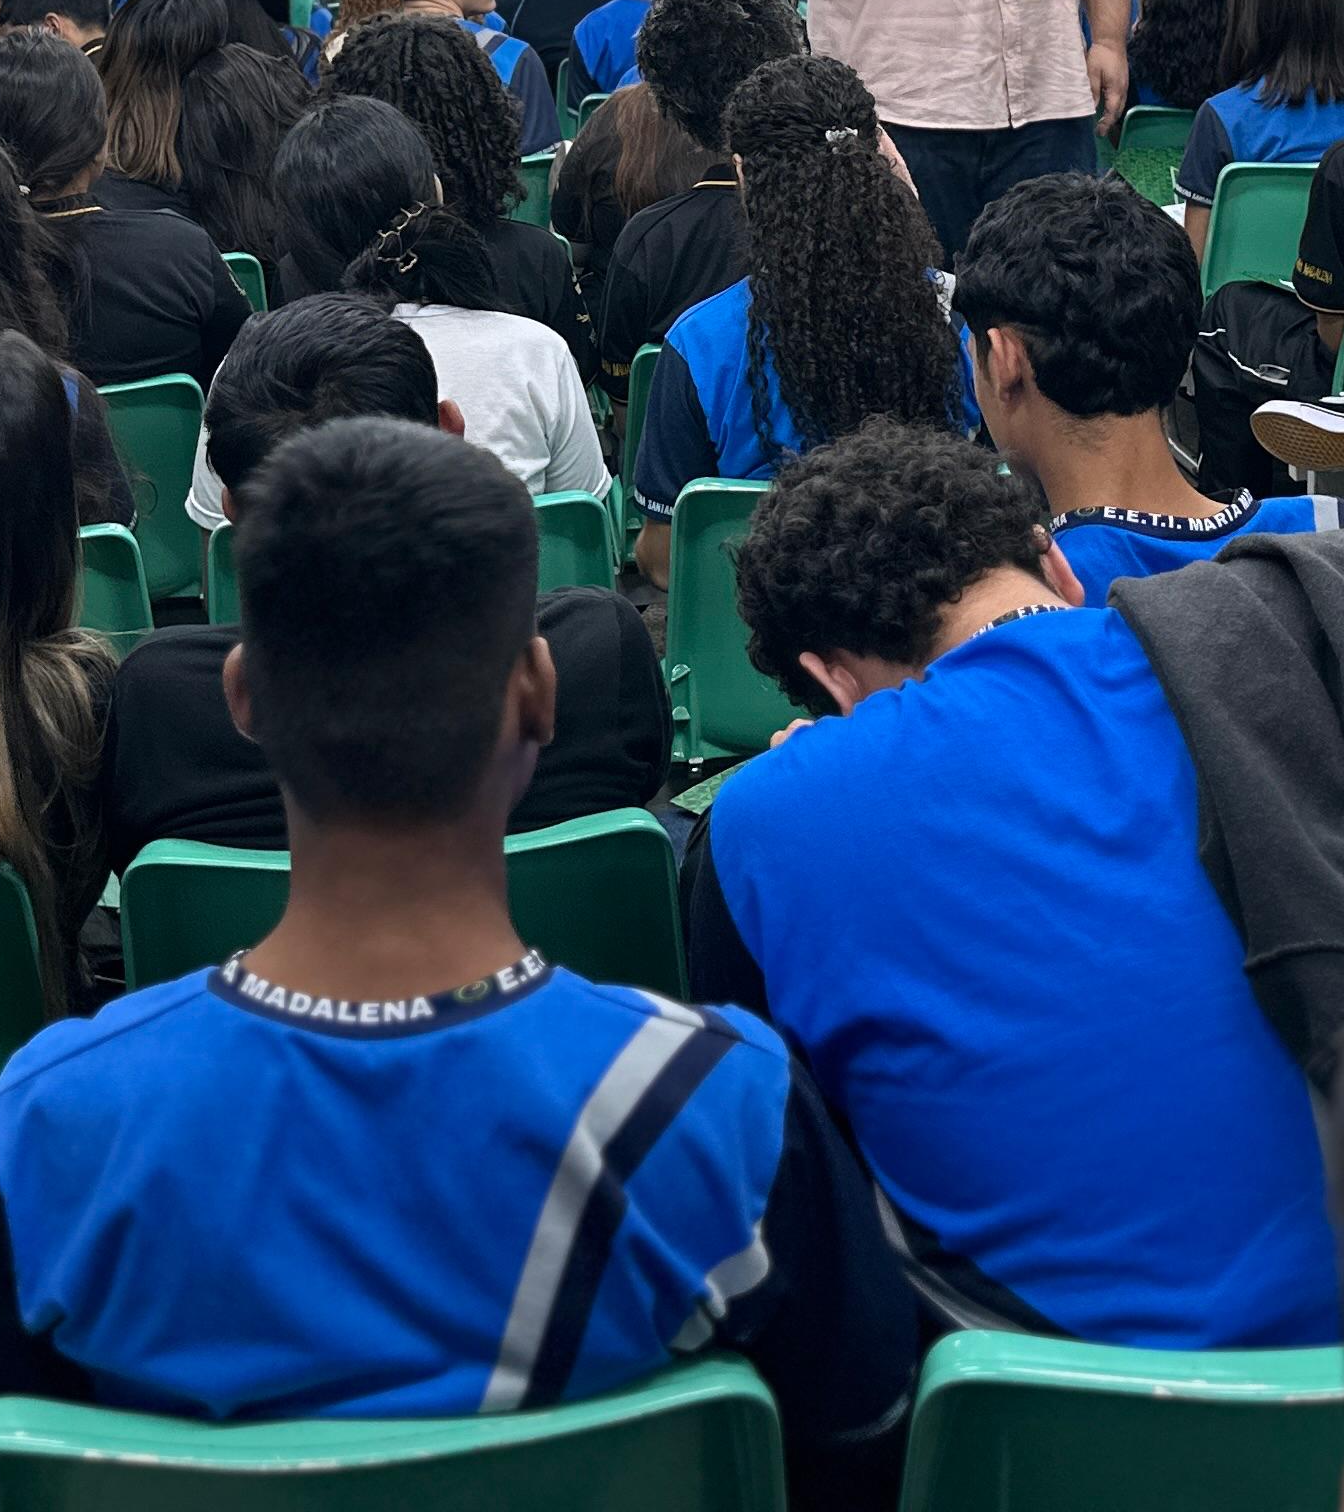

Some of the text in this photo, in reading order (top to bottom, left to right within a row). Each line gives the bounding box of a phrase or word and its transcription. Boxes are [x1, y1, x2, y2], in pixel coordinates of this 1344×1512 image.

[647, 499, 674, 515] SANTAN
[1103, 505, 1182, 530] E.E.T.I.
[1188, 502, 1244, 532] MARIA
[241, 972, 435, 1024] MADALENA
